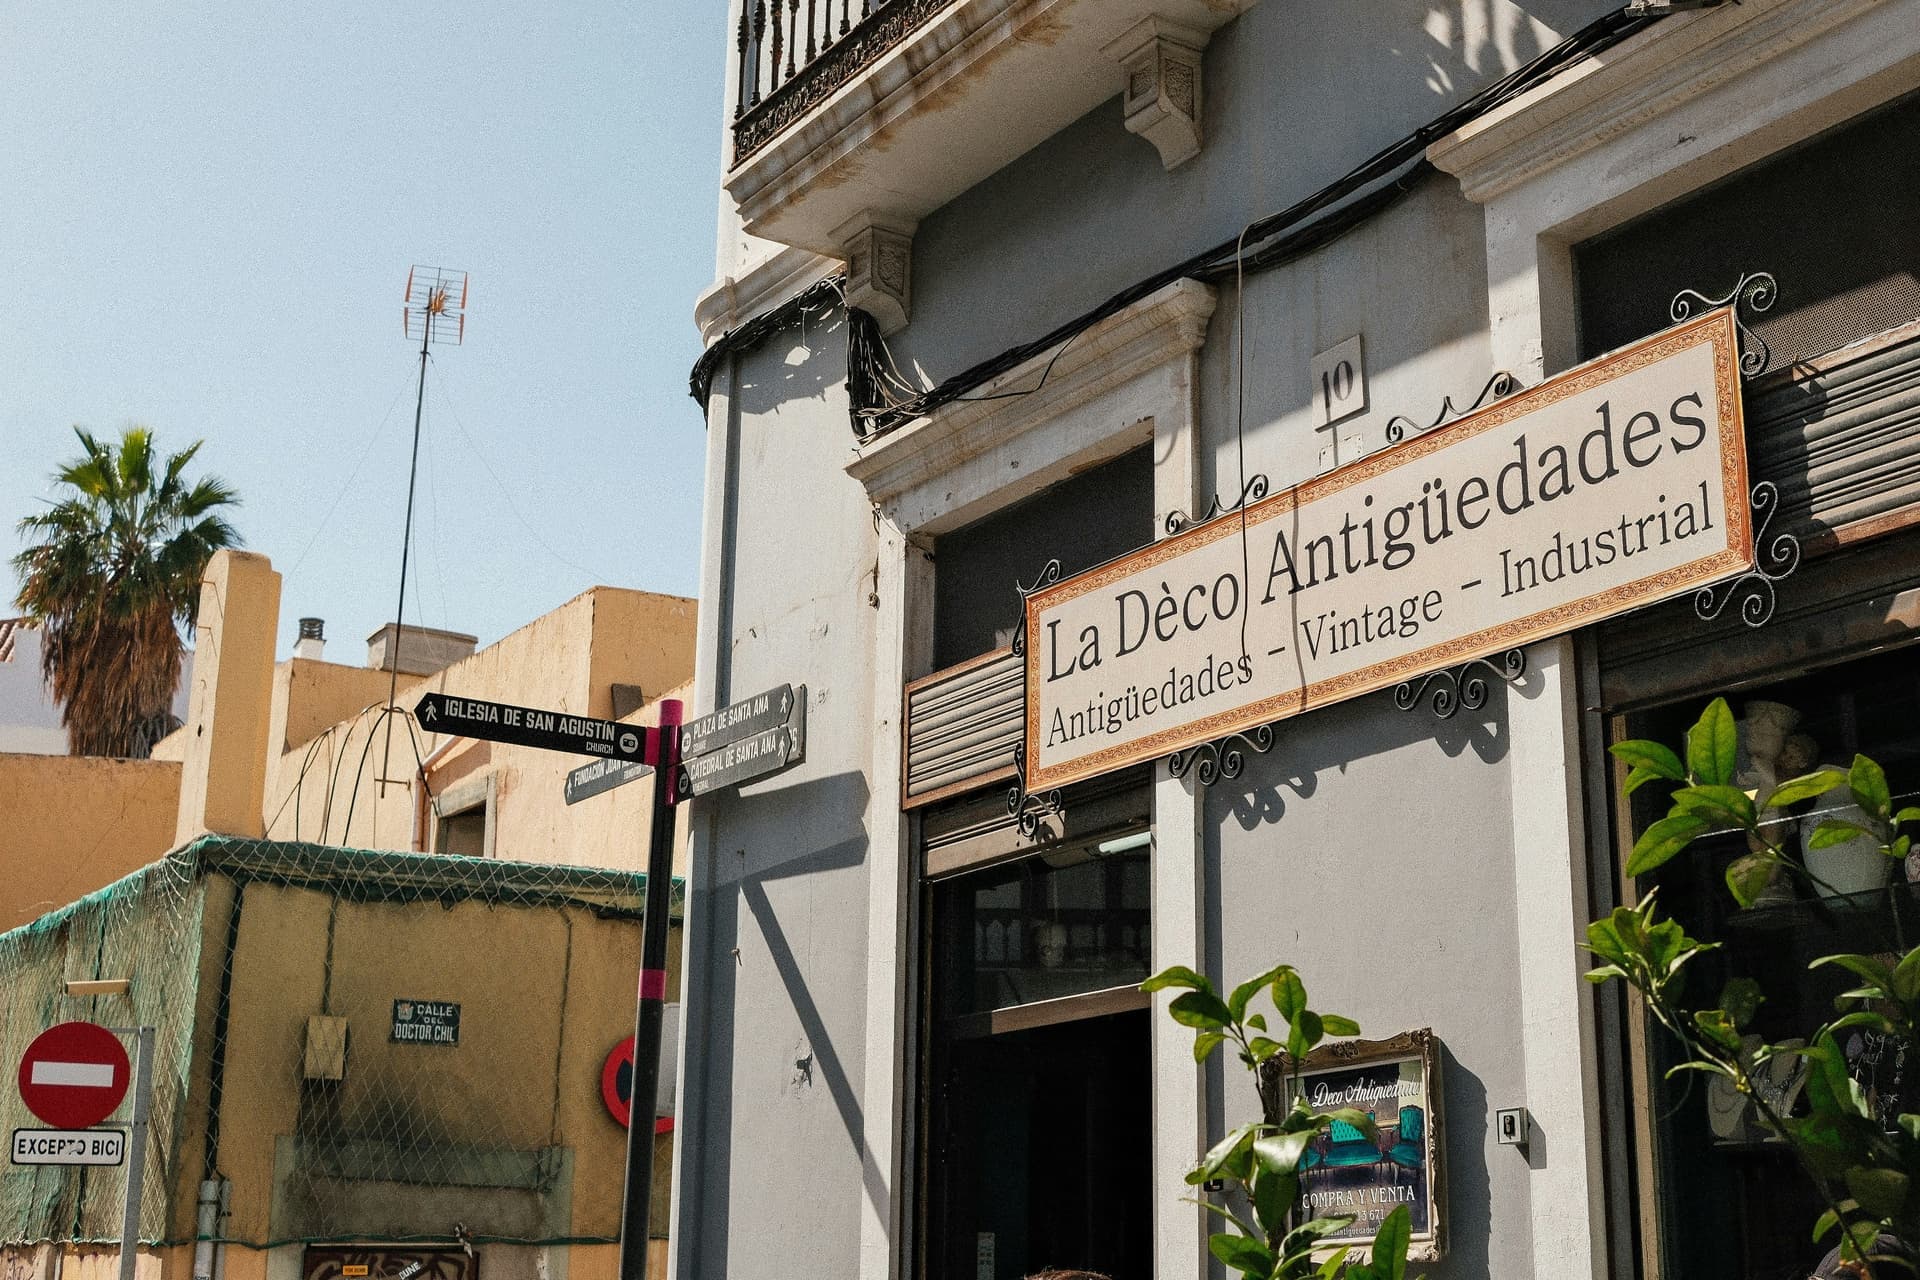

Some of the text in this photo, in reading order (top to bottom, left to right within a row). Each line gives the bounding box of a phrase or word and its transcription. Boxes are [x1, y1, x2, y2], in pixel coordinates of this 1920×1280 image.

[1322, 360, 1354, 408] 10
[1047, 391, 1707, 683] La Dèco Antigüedades
[1047, 653, 1253, 748] Antigüedades
[1300, 589, 1443, 661] Vintage
[1500, 481, 1714, 598] Industrial
[445, 698, 615, 742] IGLESIA DE SAN AGUSTÍN
[693, 695, 769, 739] PLAZA DE SANTA ANA
[585, 741, 614, 754] CHURCH
[690, 754, 724, 780] CATEDRAL
[725, 751, 734, 770] DE
[736, 741, 759, 765] SANTA
[760, 734, 776, 756] ANA
[395, 1023, 455, 1042] DOCTOR CHIL
[417, 1004, 453, 1017] CALLE
[91, 1140, 120, 1156] BICI
[1302, 1185, 1416, 1209] COMPRA Y VENTA
